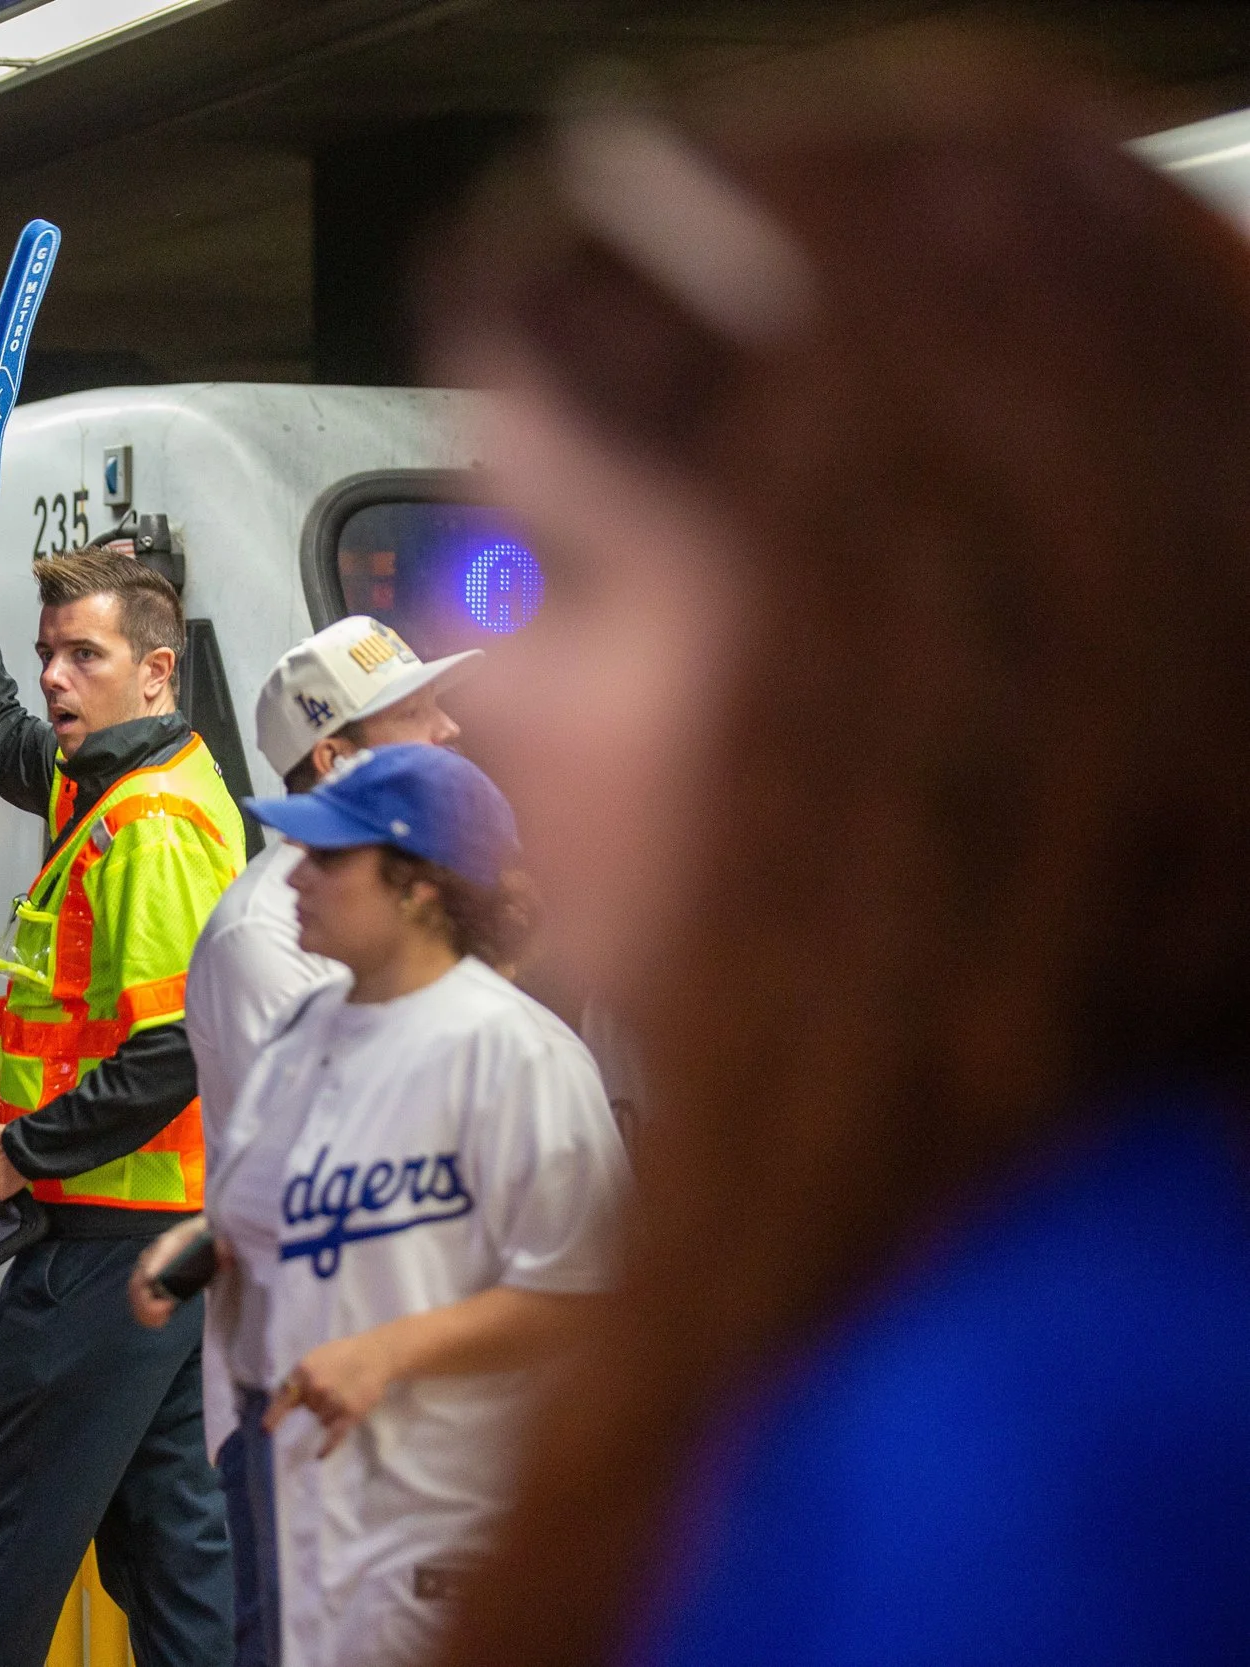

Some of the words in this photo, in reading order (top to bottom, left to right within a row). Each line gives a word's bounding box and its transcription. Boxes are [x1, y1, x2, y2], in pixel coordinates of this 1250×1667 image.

[31, 246, 49, 275] GO
[9, 280, 39, 353] METRO
[33, 488, 89, 560] 235
[293, 690, 335, 727] LA
